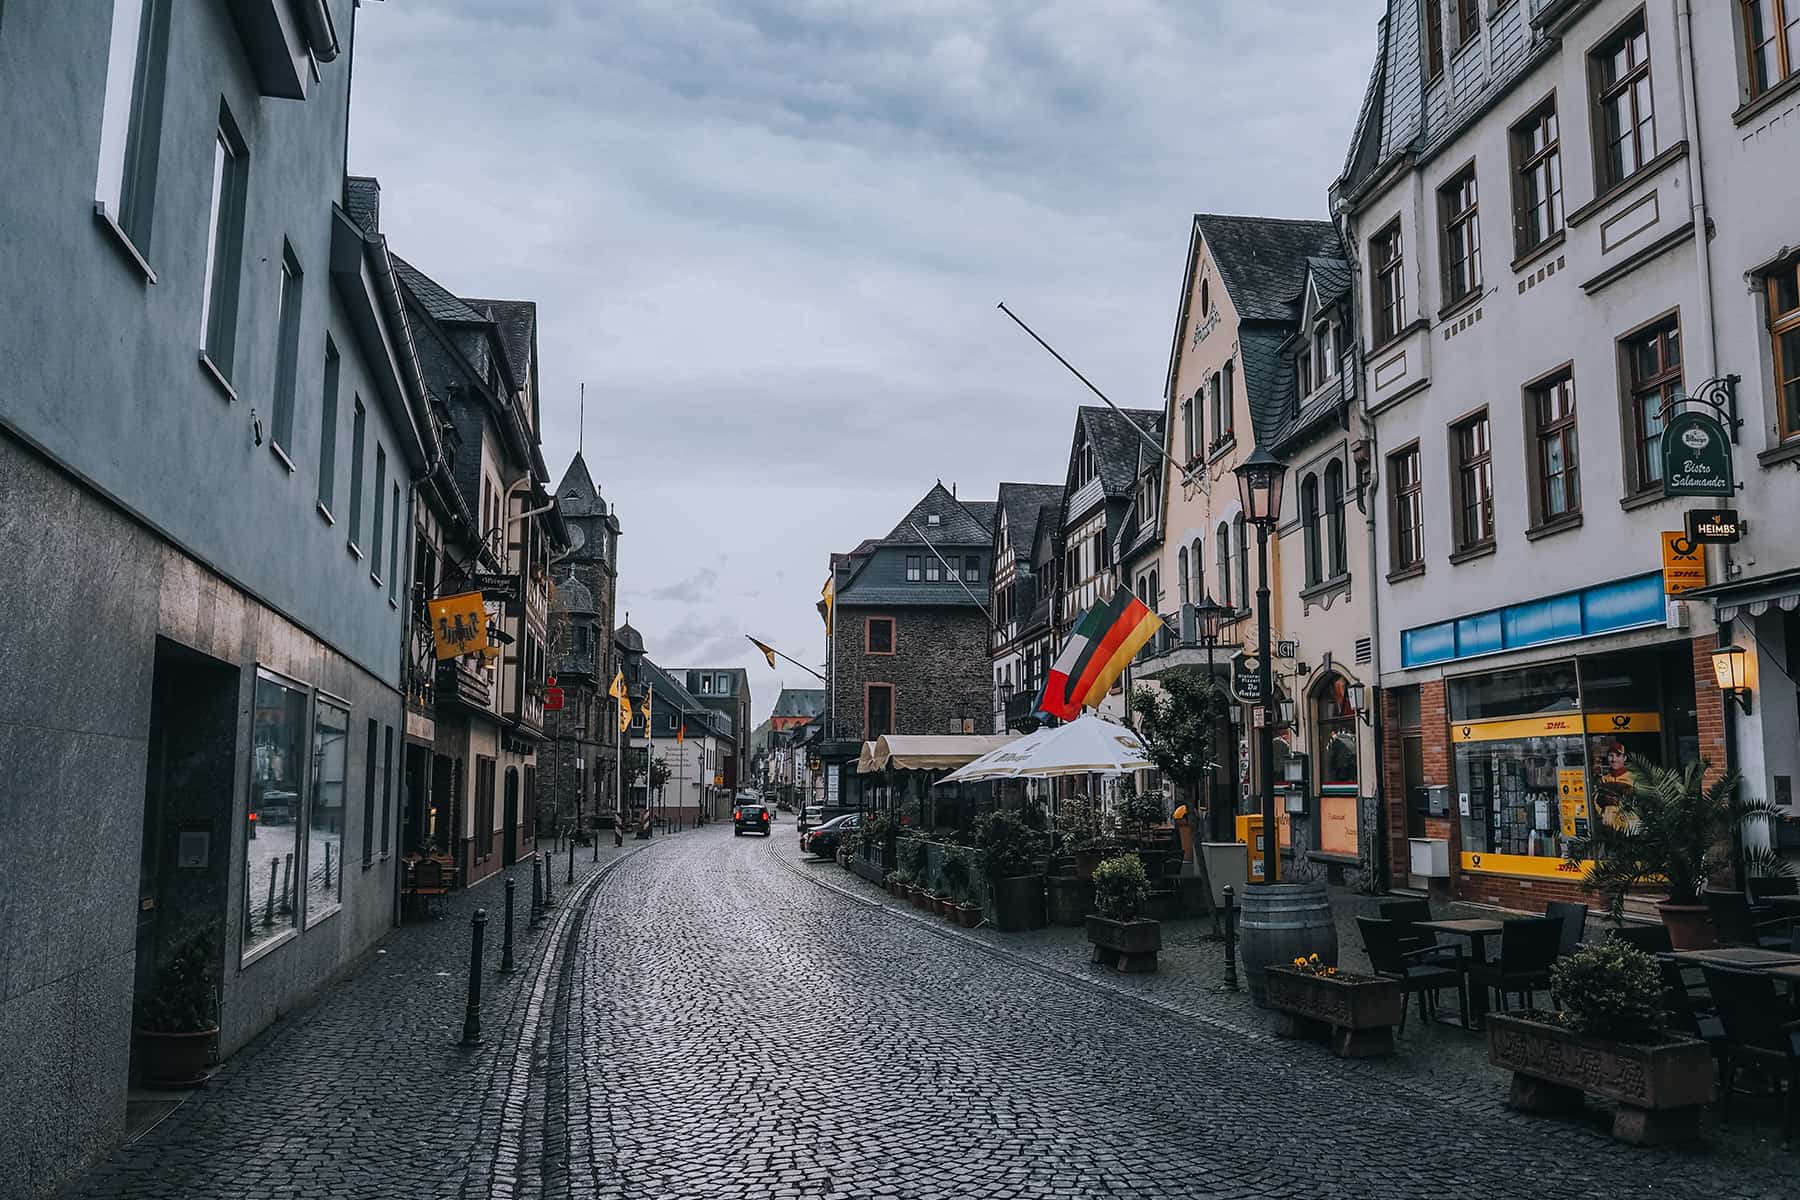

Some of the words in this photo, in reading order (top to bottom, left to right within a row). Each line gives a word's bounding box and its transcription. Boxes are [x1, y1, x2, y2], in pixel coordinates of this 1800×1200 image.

[1683, 460, 1711, 473] Bistro
[1671, 474, 1726, 487] Salamander
[1697, 524, 1736, 534] HEIMBS
[1546, 721, 1567, 729] DHL
[1556, 863, 1582, 873] DHL
